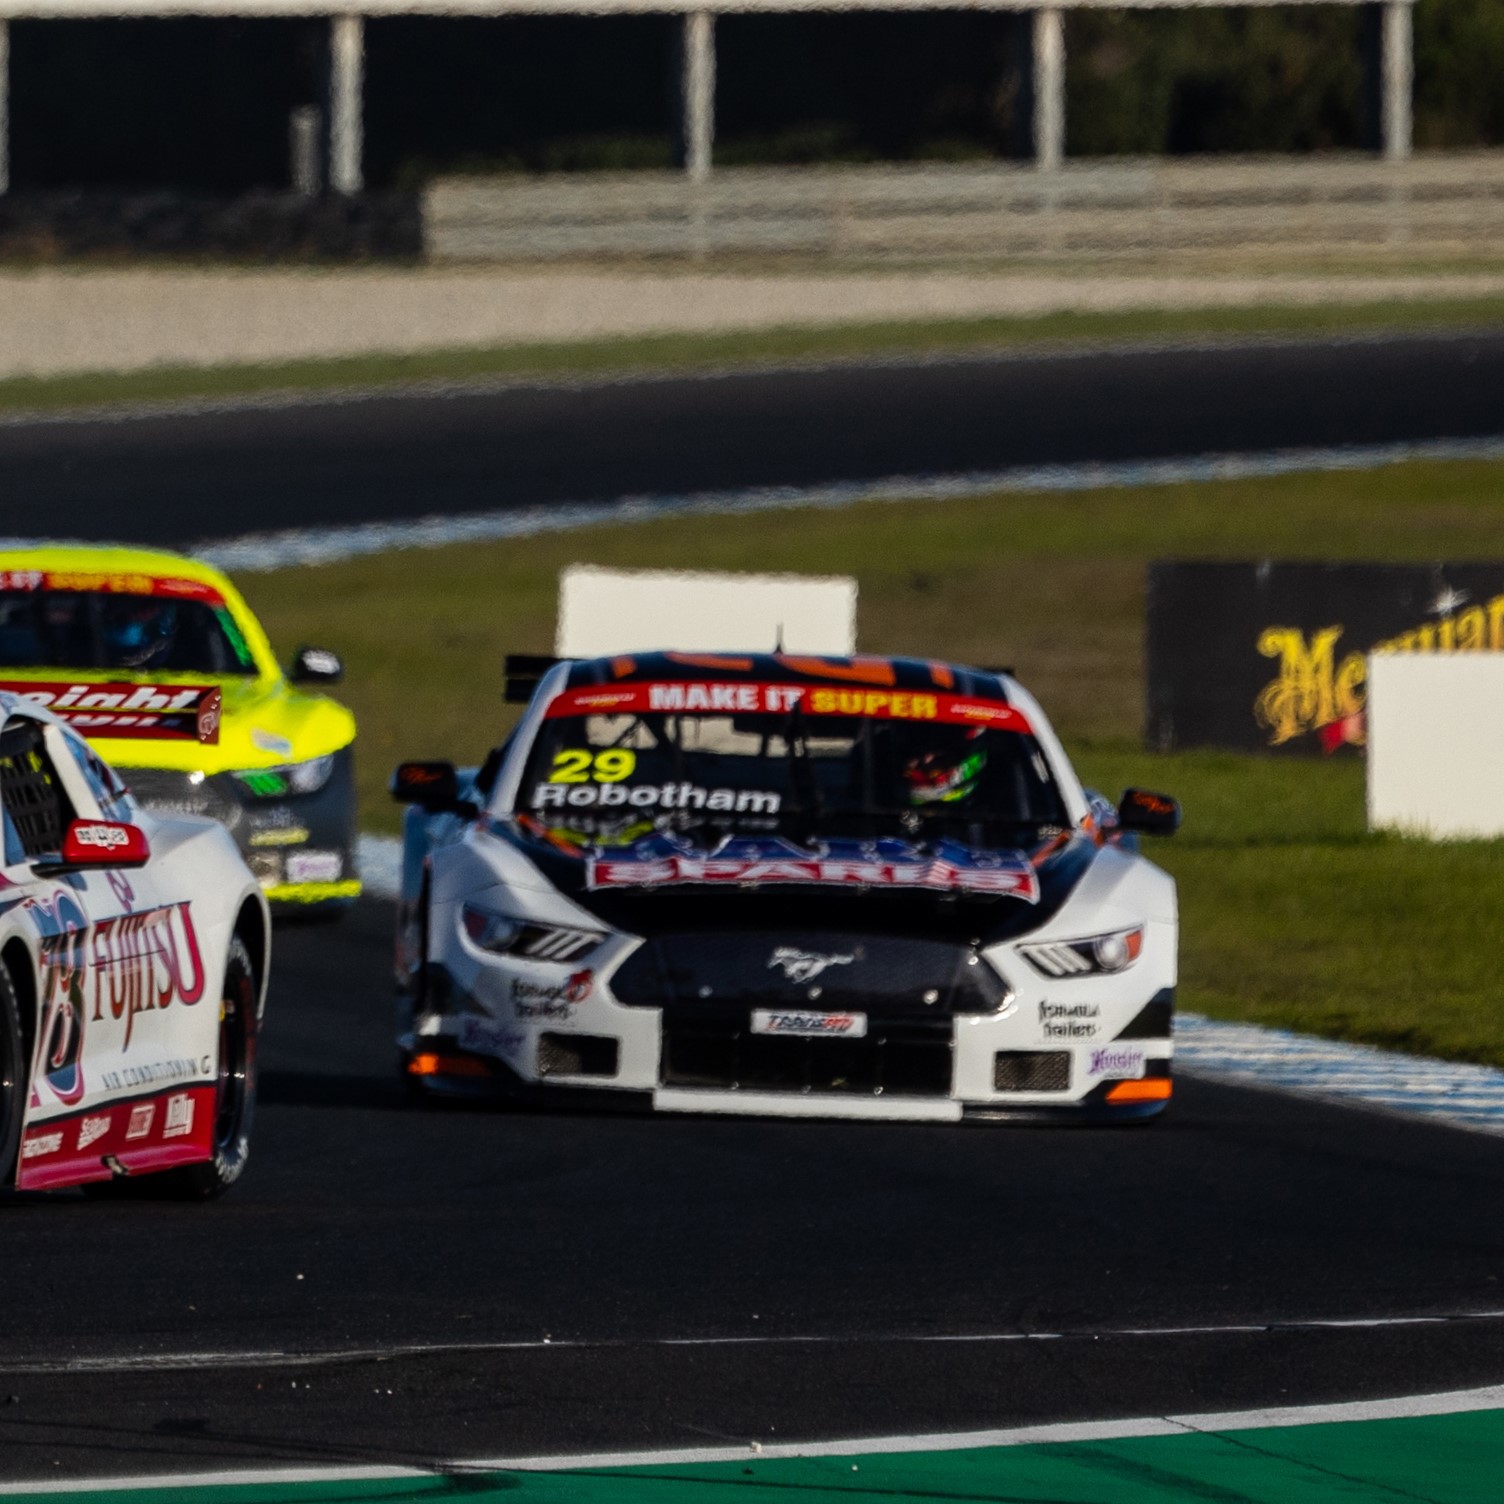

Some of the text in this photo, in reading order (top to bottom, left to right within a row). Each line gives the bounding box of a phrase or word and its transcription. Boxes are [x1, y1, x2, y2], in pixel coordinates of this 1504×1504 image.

[649, 683, 760, 710] MAKE
[765, 685, 805, 711] IT
[811, 688, 937, 718] SUPER
[548, 748, 636, 784] 29
[532, 782, 782, 814] Robotham
